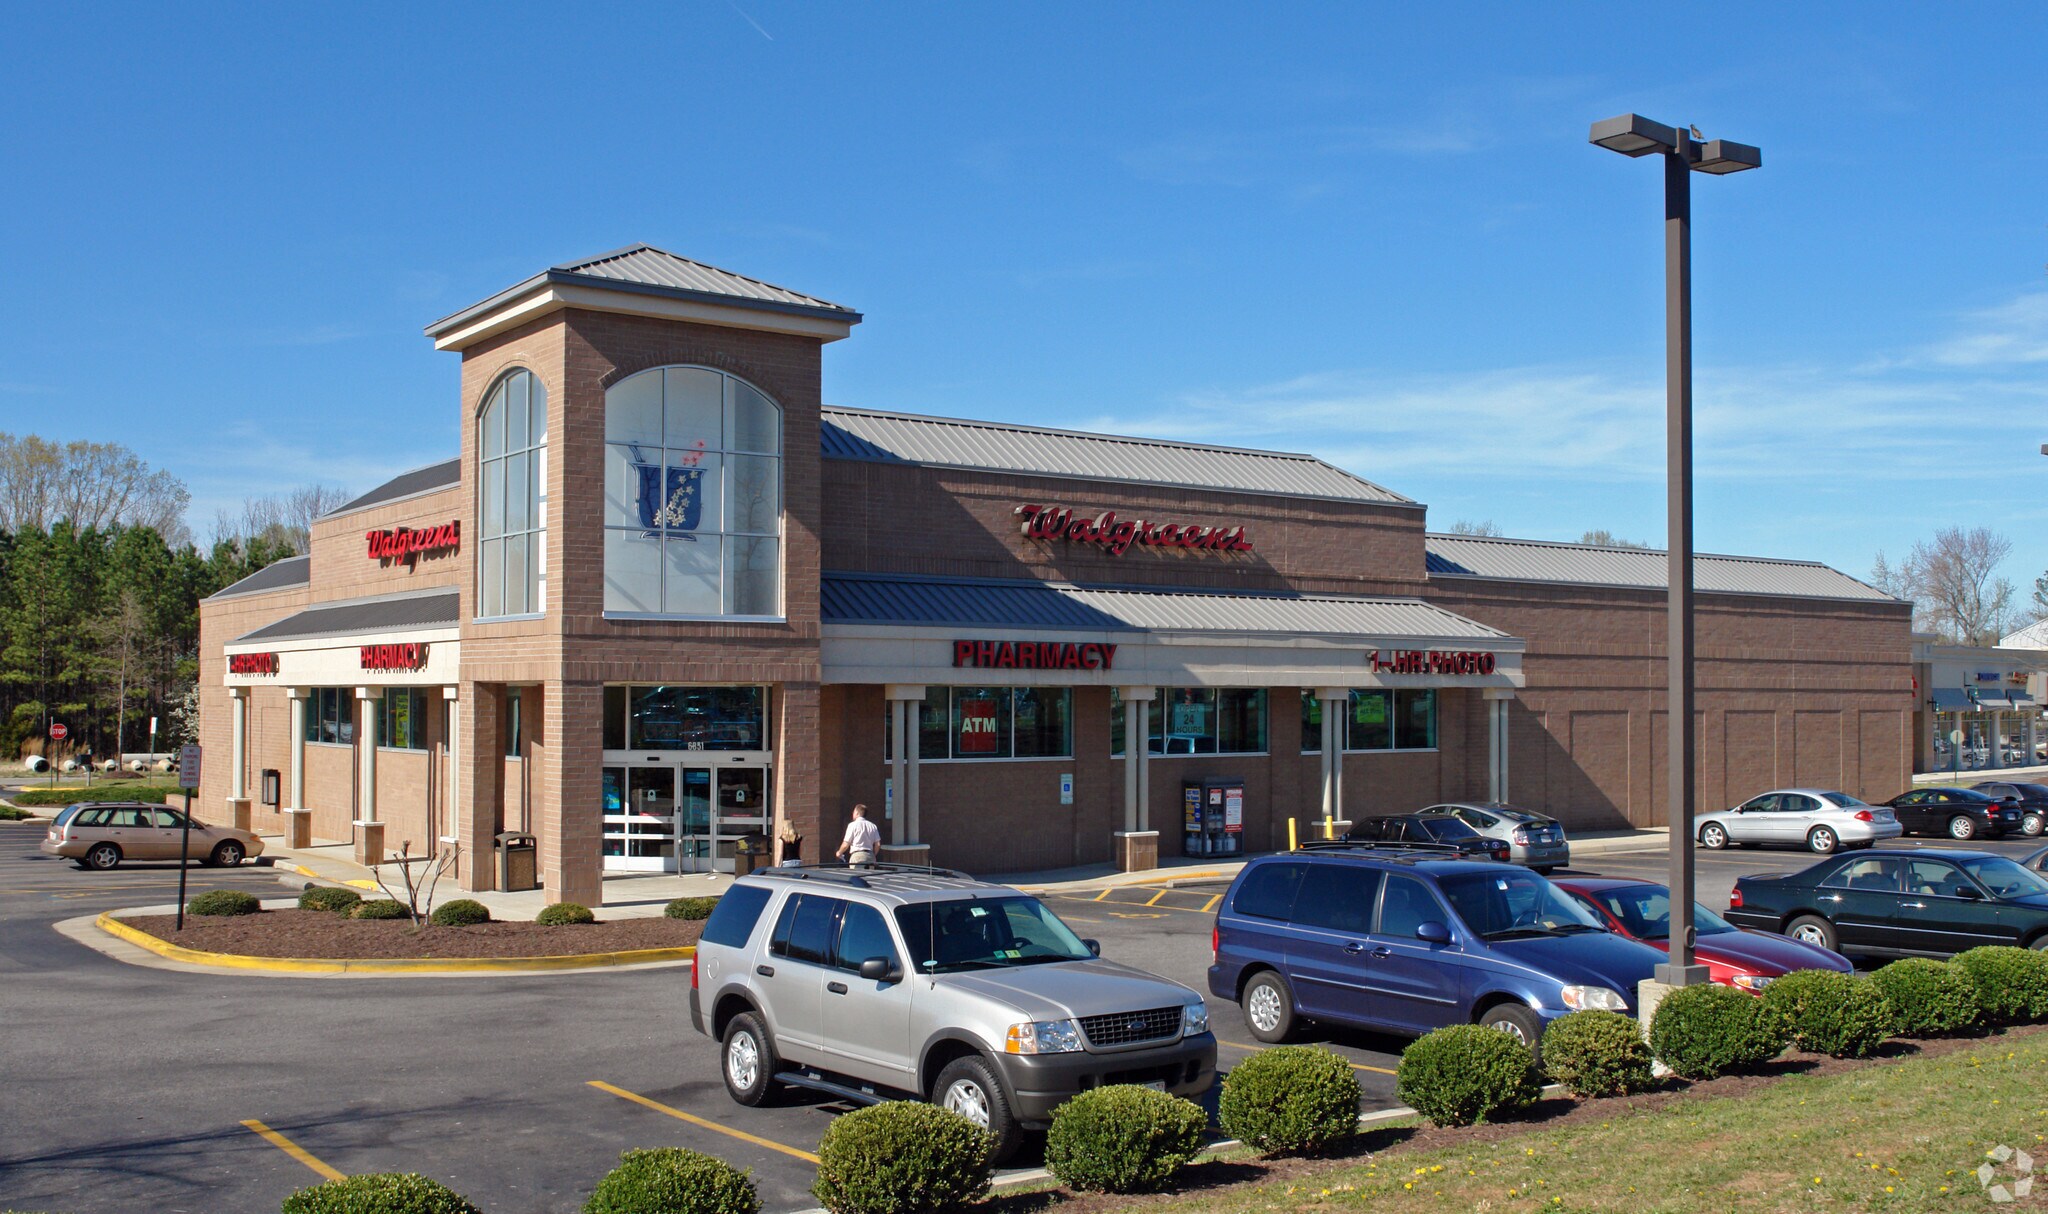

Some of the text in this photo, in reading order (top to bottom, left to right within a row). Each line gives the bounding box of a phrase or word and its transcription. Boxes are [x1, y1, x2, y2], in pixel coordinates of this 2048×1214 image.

[1014, 504, 1254, 555] Walgreens
[366, 520, 459, 566] Walgreens
[361, 643, 422, 669] PHARMACY
[954, 640, 1118, 669] PHARMACY
[1428, 651, 1496, 674] PHOTO
[961, 717, 996, 733] ATM
[1183, 714, 1195, 725] 24
